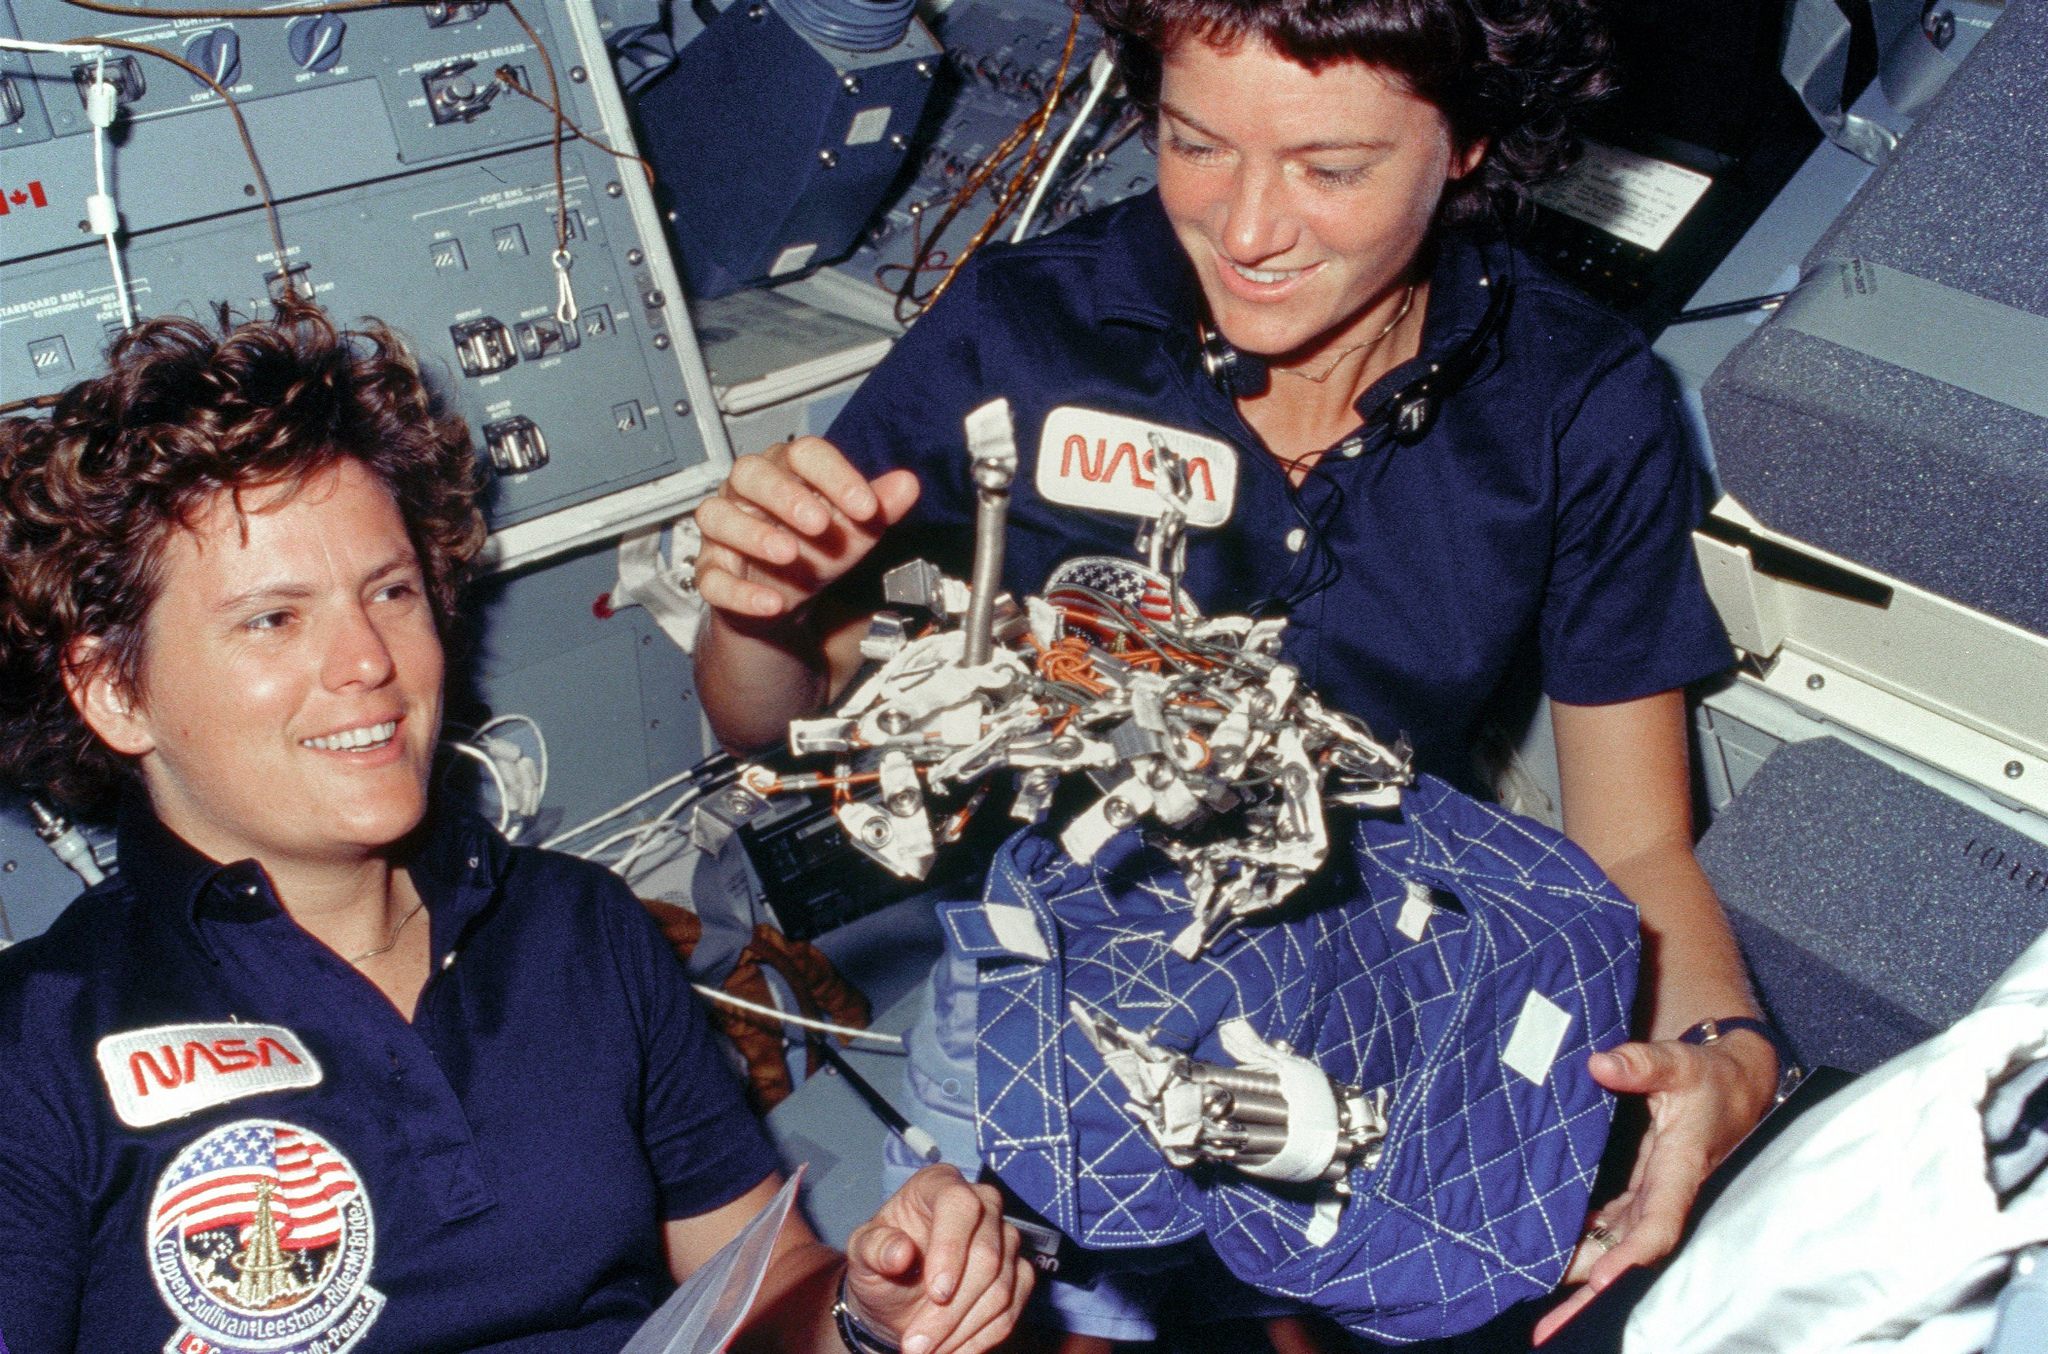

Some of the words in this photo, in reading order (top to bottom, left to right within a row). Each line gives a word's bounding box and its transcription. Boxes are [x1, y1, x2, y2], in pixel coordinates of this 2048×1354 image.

[0, 296, 58, 318] TARBOARD
[61, 289, 84, 303] RMS
[33, 302, 79, 318] RETENTION
[81, 292, 116, 308] LATCHES
[129, 1037, 302, 1096] NASA
[158, 1239, 191, 1300] Crippen
[188, 1294, 249, 1336] Sullivan
[257, 1303, 326, 1338] Leestma
[323, 1271, 355, 1305] Ride
[344, 1206, 369, 1268] McBride
